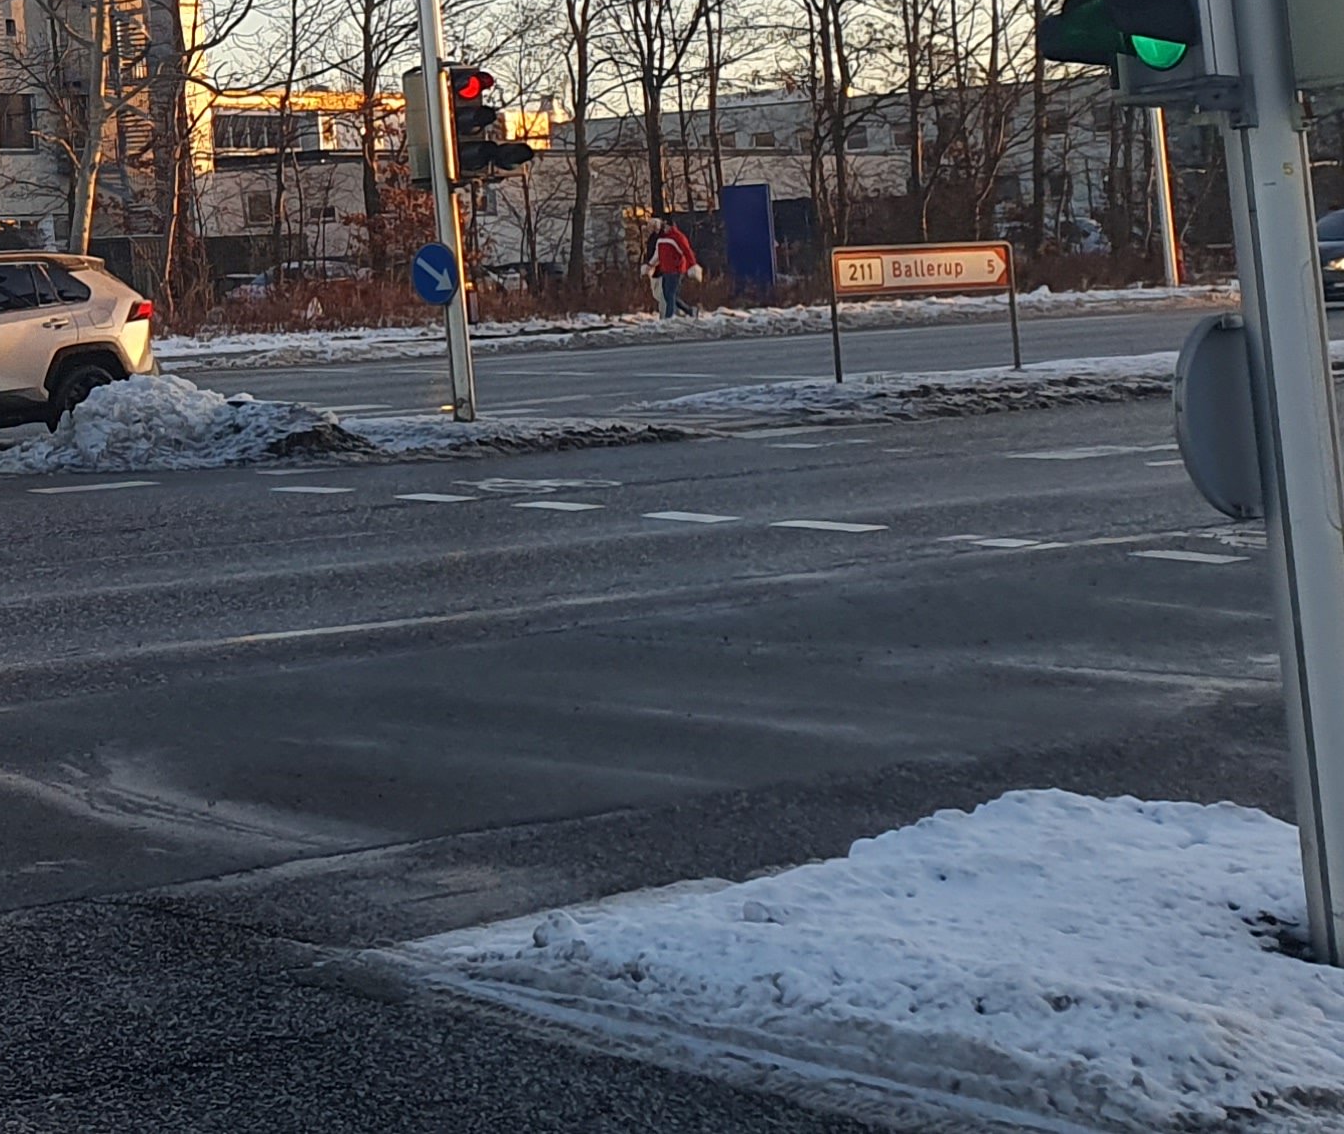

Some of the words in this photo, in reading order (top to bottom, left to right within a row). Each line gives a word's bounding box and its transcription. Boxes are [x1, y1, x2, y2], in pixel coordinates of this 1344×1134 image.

[1282, 162, 1294, 176] 5
[848, 263, 874, 282] 211
[891, 258, 964, 279] Ballerup
[986, 258, 996, 275] 5
